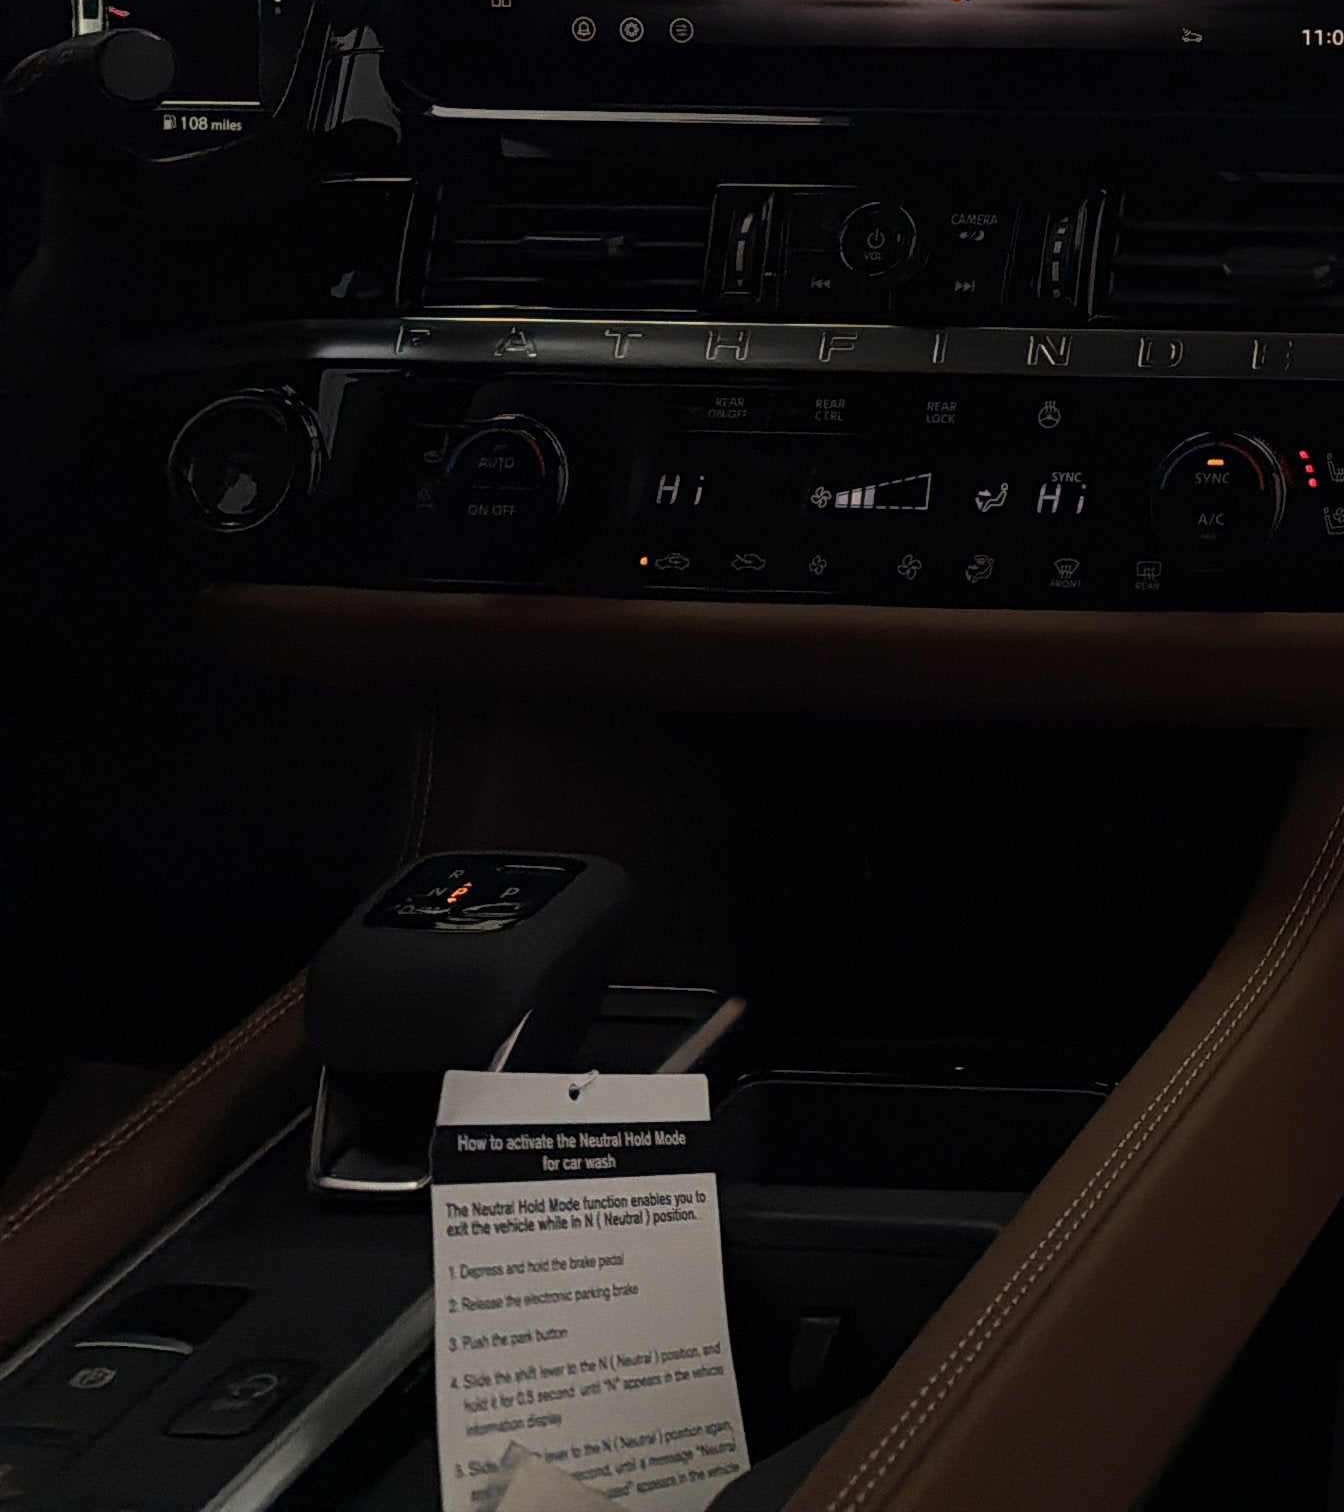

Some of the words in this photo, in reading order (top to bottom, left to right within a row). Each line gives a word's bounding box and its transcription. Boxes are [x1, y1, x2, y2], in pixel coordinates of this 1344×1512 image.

[180, 116, 208, 131] 108
[210, 117, 243, 132] miles
[951, 213, 998, 225] CAMERA
[815, 398, 845, 409] REAR
[927, 401, 957, 412] REAR
[926, 413, 956, 424] LOCK
[477, 456, 515, 470] AUTO
[1051, 471, 1083, 483] SYNC
[1194, 472, 1231, 485] SYNC
[1198, 513, 1225, 526] A/C
[500, 887, 520, 899] P
[457, 1133, 488, 1152] How
[489, 1133, 503, 1151] to
[506, 1133, 554, 1151] activate
[556, 1132, 577, 1149] the
[579, 1131, 622, 1148] Neutral
[624, 1130, 652, 1147] Hold
[654, 1129, 687, 1146] Mode
[542, 1154, 560, 1172] for
[562, 1157, 583, 1170] car
[584, 1153, 617, 1170] wash
[446, 1202, 468, 1218] The
[472, 1199, 515, 1217] Neutral
[518, 1199, 546, 1214] Hold
[548, 1197, 580, 1212] Mode
[582, 1194, 628, 1209] function
[631, 1192, 672, 1208] enables
[674, 1192, 693, 1208] you
[695, 1190, 706, 1204] to
[446, 1221, 469, 1237] exit
[471, 1221, 491, 1236] the
[493, 1217, 535, 1234] vehicle
[537, 1214, 569, 1231] while
[570, 1214, 581, 1229] in
[584, 1213, 594, 1228] N
[604, 1209, 643, 1227] Neutral
[653, 1208, 698, 1226] position.
